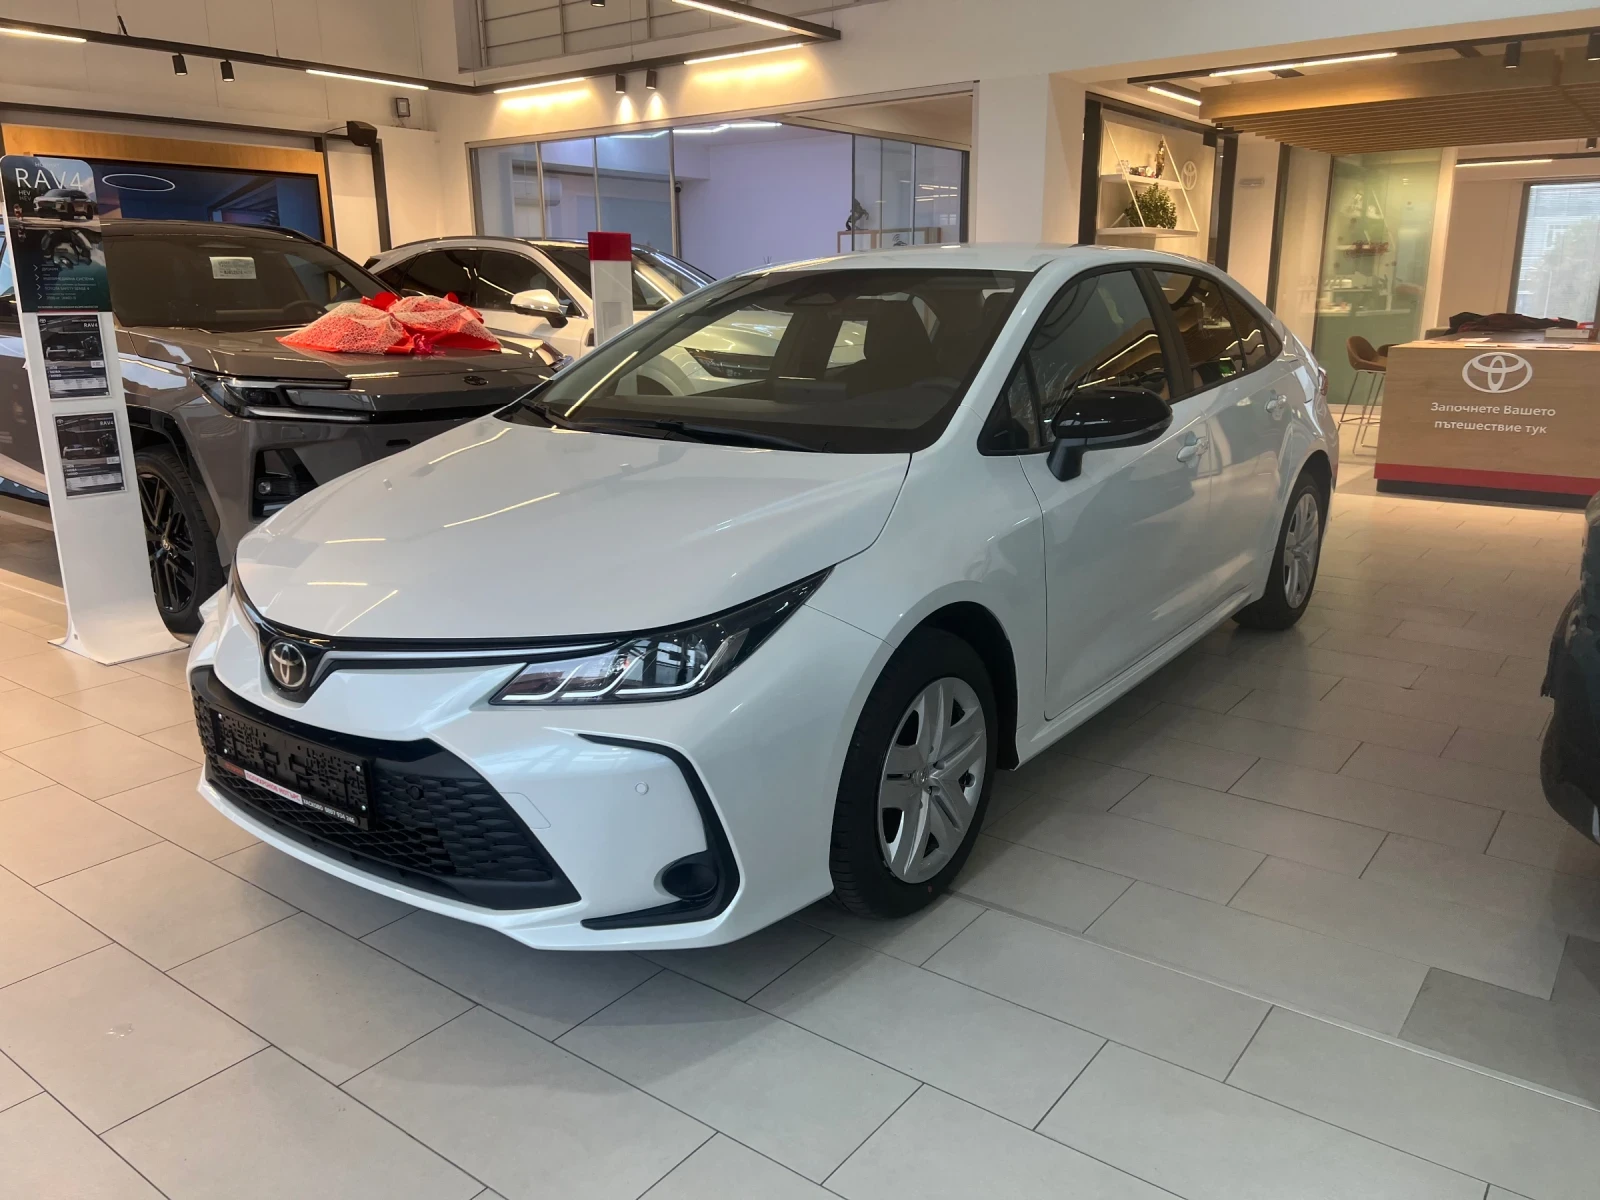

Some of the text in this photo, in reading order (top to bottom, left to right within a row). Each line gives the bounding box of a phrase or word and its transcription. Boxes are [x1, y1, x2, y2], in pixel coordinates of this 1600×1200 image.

[15, 168, 83, 190] RAV4
[1430, 402, 1556, 416] Започнете Вашето
[1434, 420, 1548, 435] пътешествие тук
